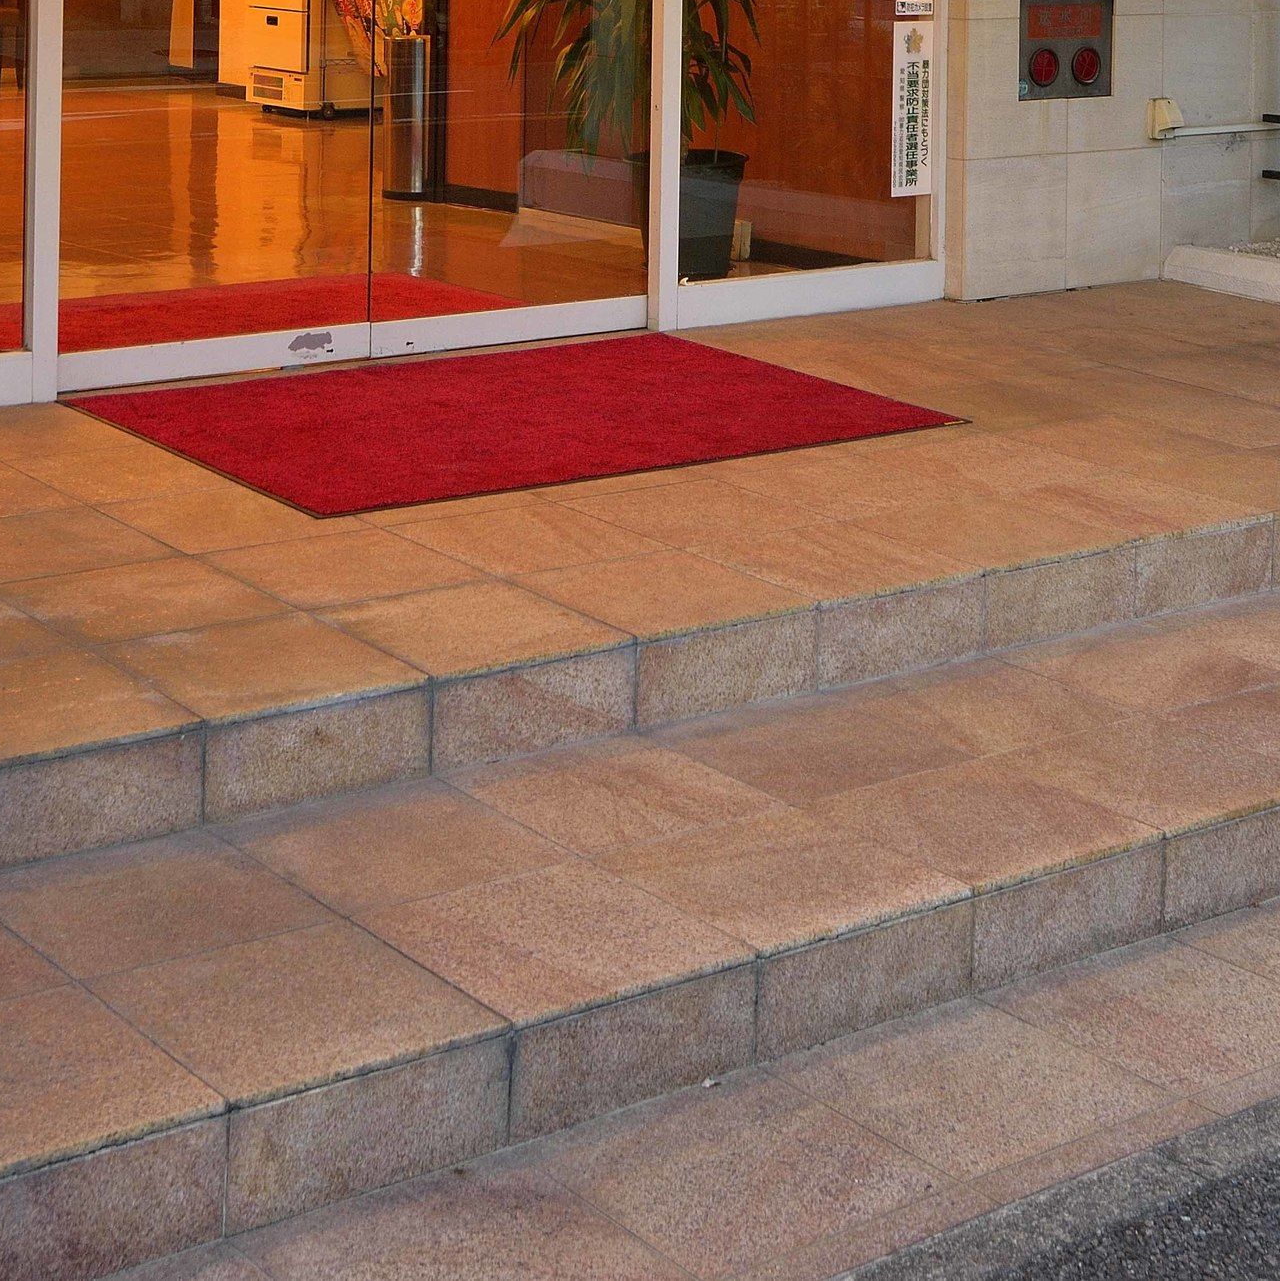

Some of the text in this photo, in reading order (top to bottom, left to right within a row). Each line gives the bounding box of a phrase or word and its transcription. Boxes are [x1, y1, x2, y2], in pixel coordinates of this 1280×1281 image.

[905, 61, 920, 187] 不当要求防止責任者選任事業所
